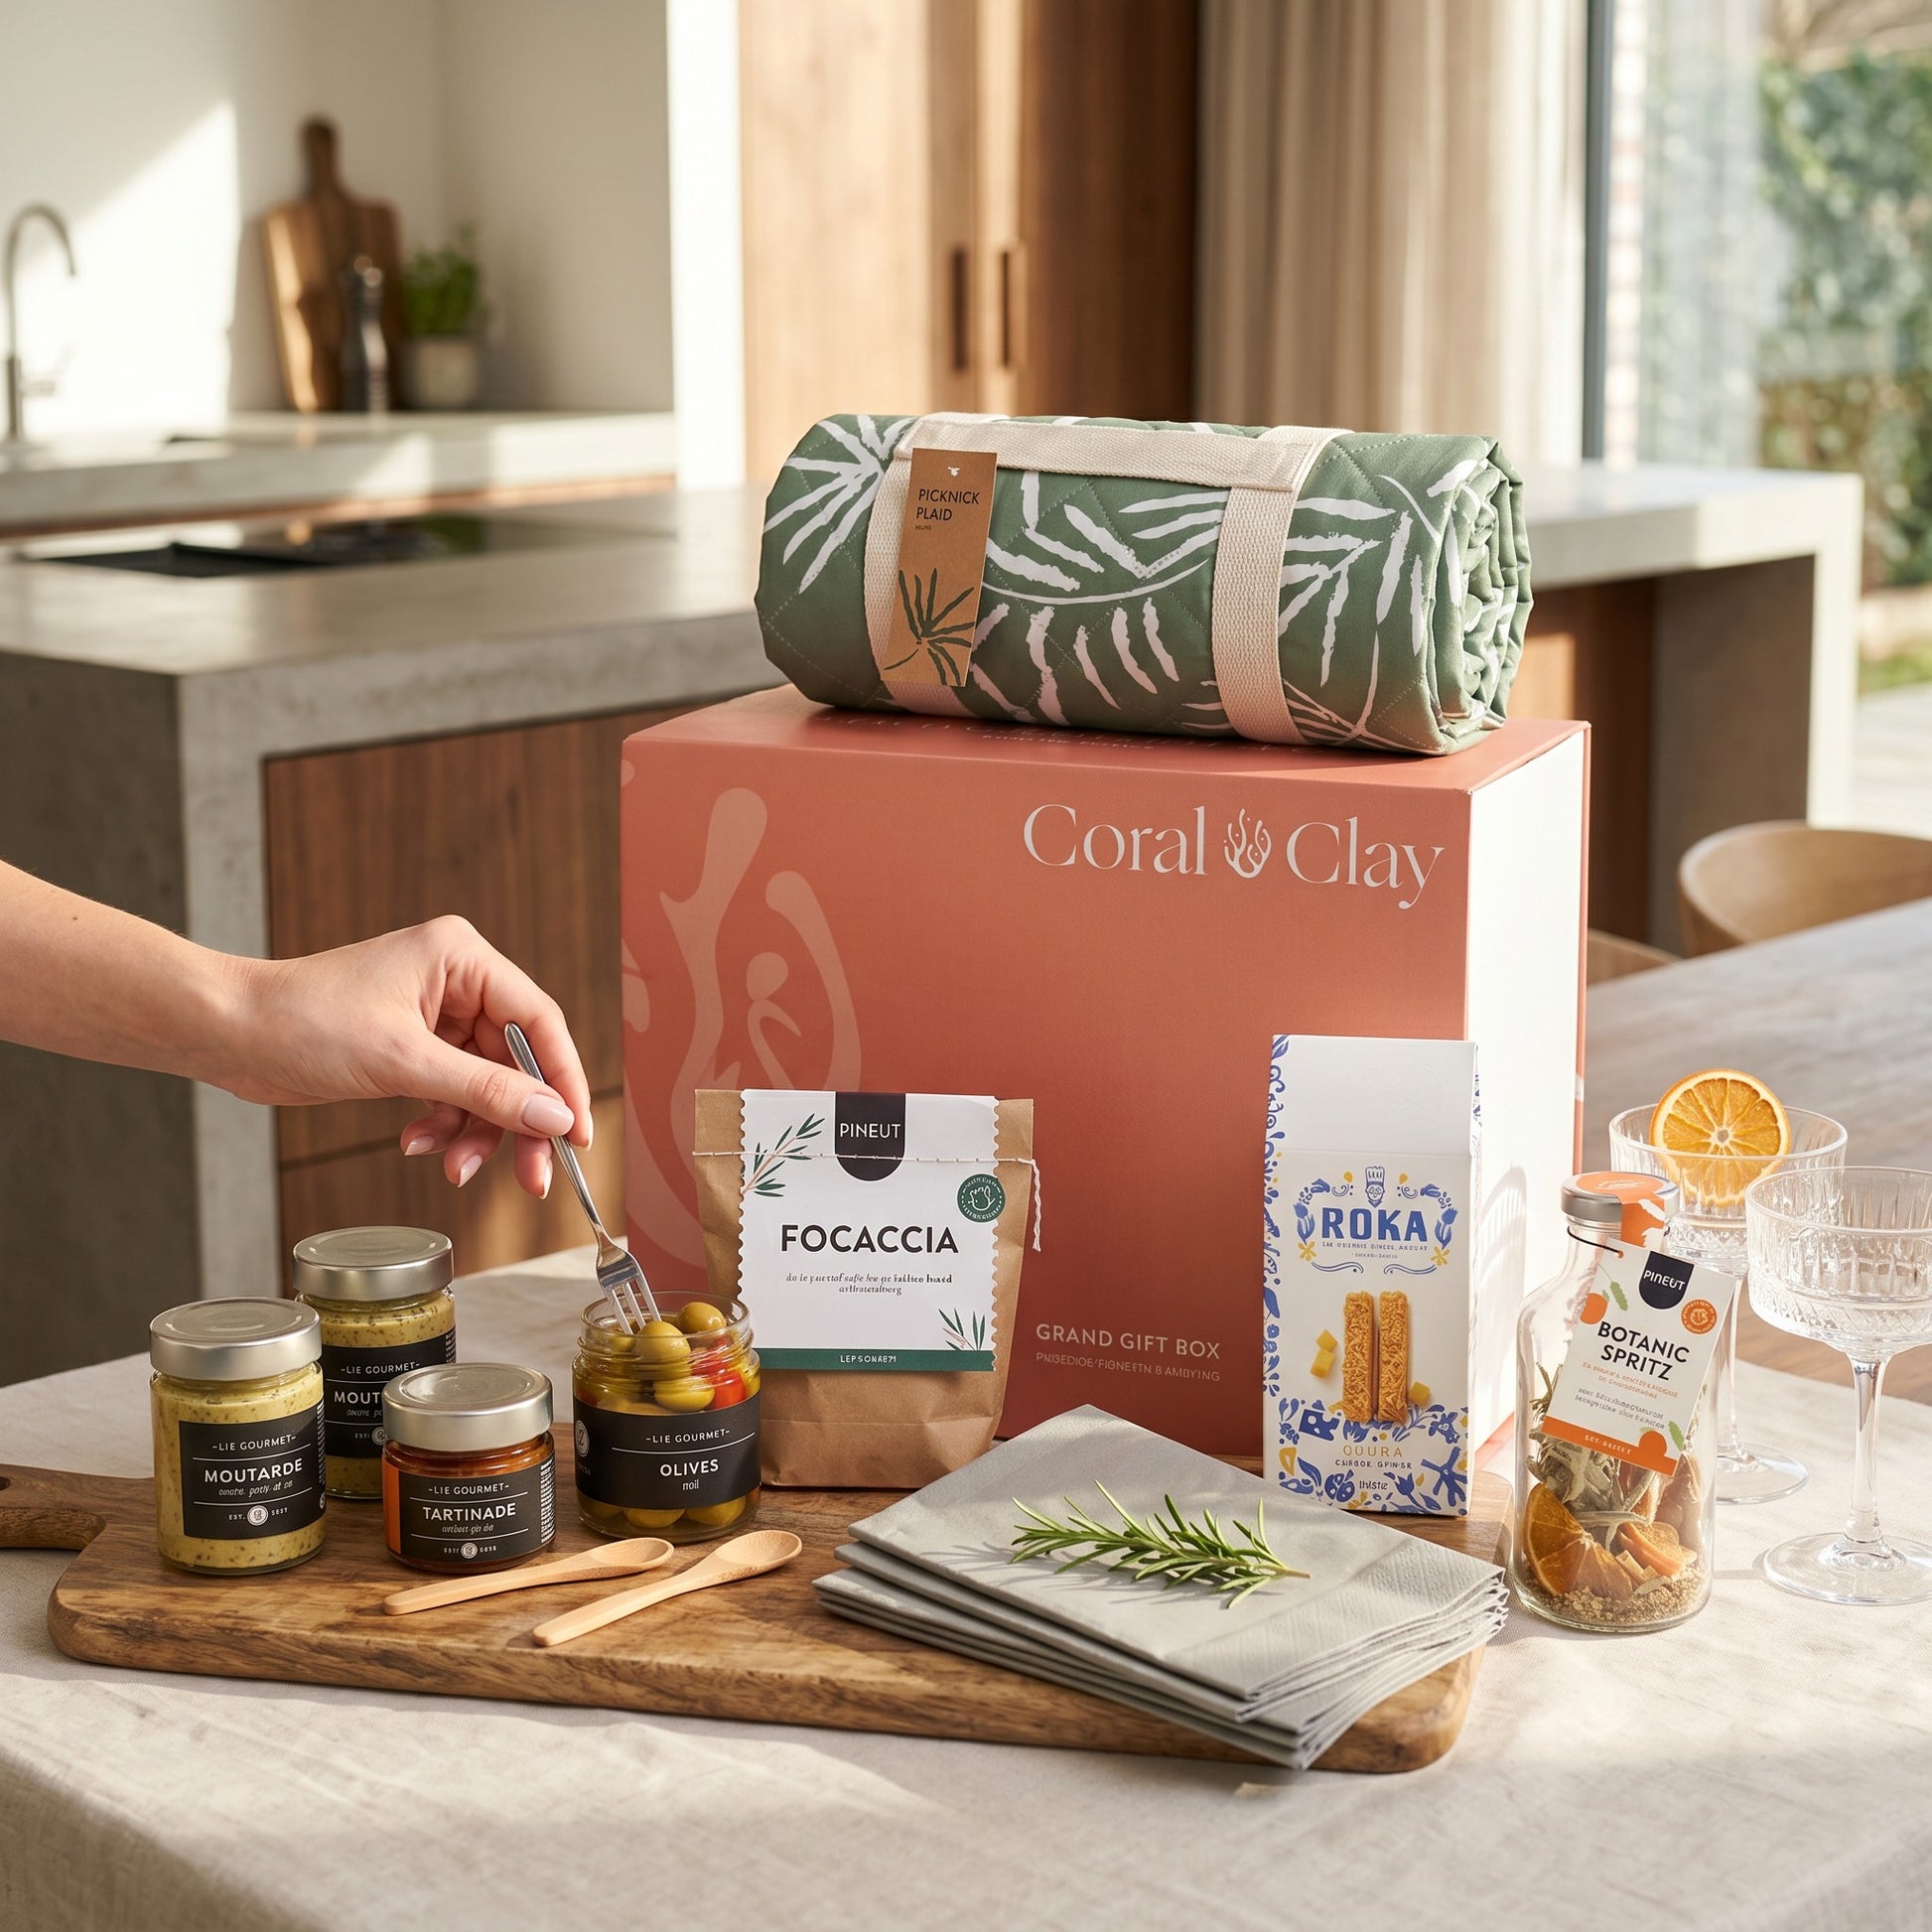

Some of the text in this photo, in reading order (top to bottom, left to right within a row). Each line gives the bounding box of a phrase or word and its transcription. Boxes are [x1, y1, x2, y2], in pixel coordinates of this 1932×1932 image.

[918, 488, 980, 505] PICKNICK
[916, 507, 952, 521] PLAID
[1023, 803, 1445, 909] Coral Clay
[840, 1123, 901, 1139] PINEUT
[1321, 1207, 1428, 1242] ROKA
[781, 1224, 959, 1254] FOCACCIA
[1643, 1270, 1686, 1291] PINEUT
[1035, 1323, 1220, 1359] GRAND GIFT BOX
[1597, 1320, 1690, 1363] BOTANIC
[1600, 1344, 1673, 1381] SPRITZ
[334, 1390, 380, 1404] MOUT
[205, 1457, 303, 1483] MOUTARDE
[659, 1458, 719, 1477] OLIVES
[422, 1502, 516, 1521] TARTINADE
